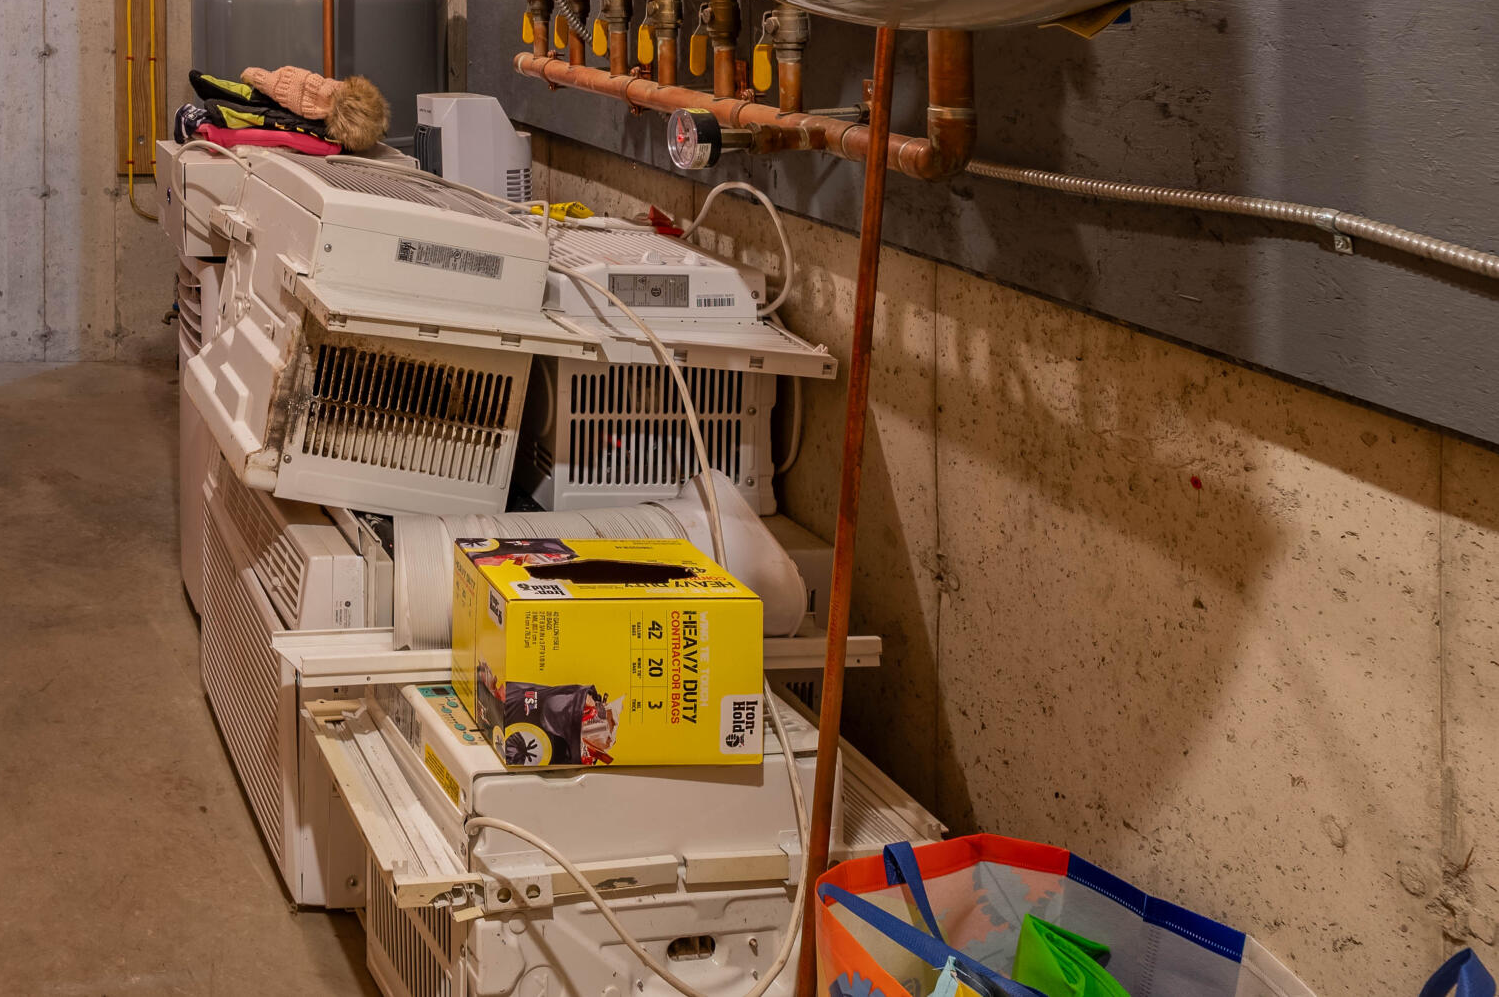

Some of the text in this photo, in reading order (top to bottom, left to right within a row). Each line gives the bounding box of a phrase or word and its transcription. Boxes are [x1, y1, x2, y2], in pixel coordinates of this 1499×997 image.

[648, 620, 663, 640] 42
[648, 658, 663, 678] 20
[670, 610, 681, 725] CONTRACTOR BAGS
[682, 610, 698, 724] HEAVY DUTY
[700, 611, 710, 707] WING TIE TOUGH
[648, 701, 663, 710] 3
[732, 701, 746, 733] Hold
[745, 701, 758, 735] Iron-
